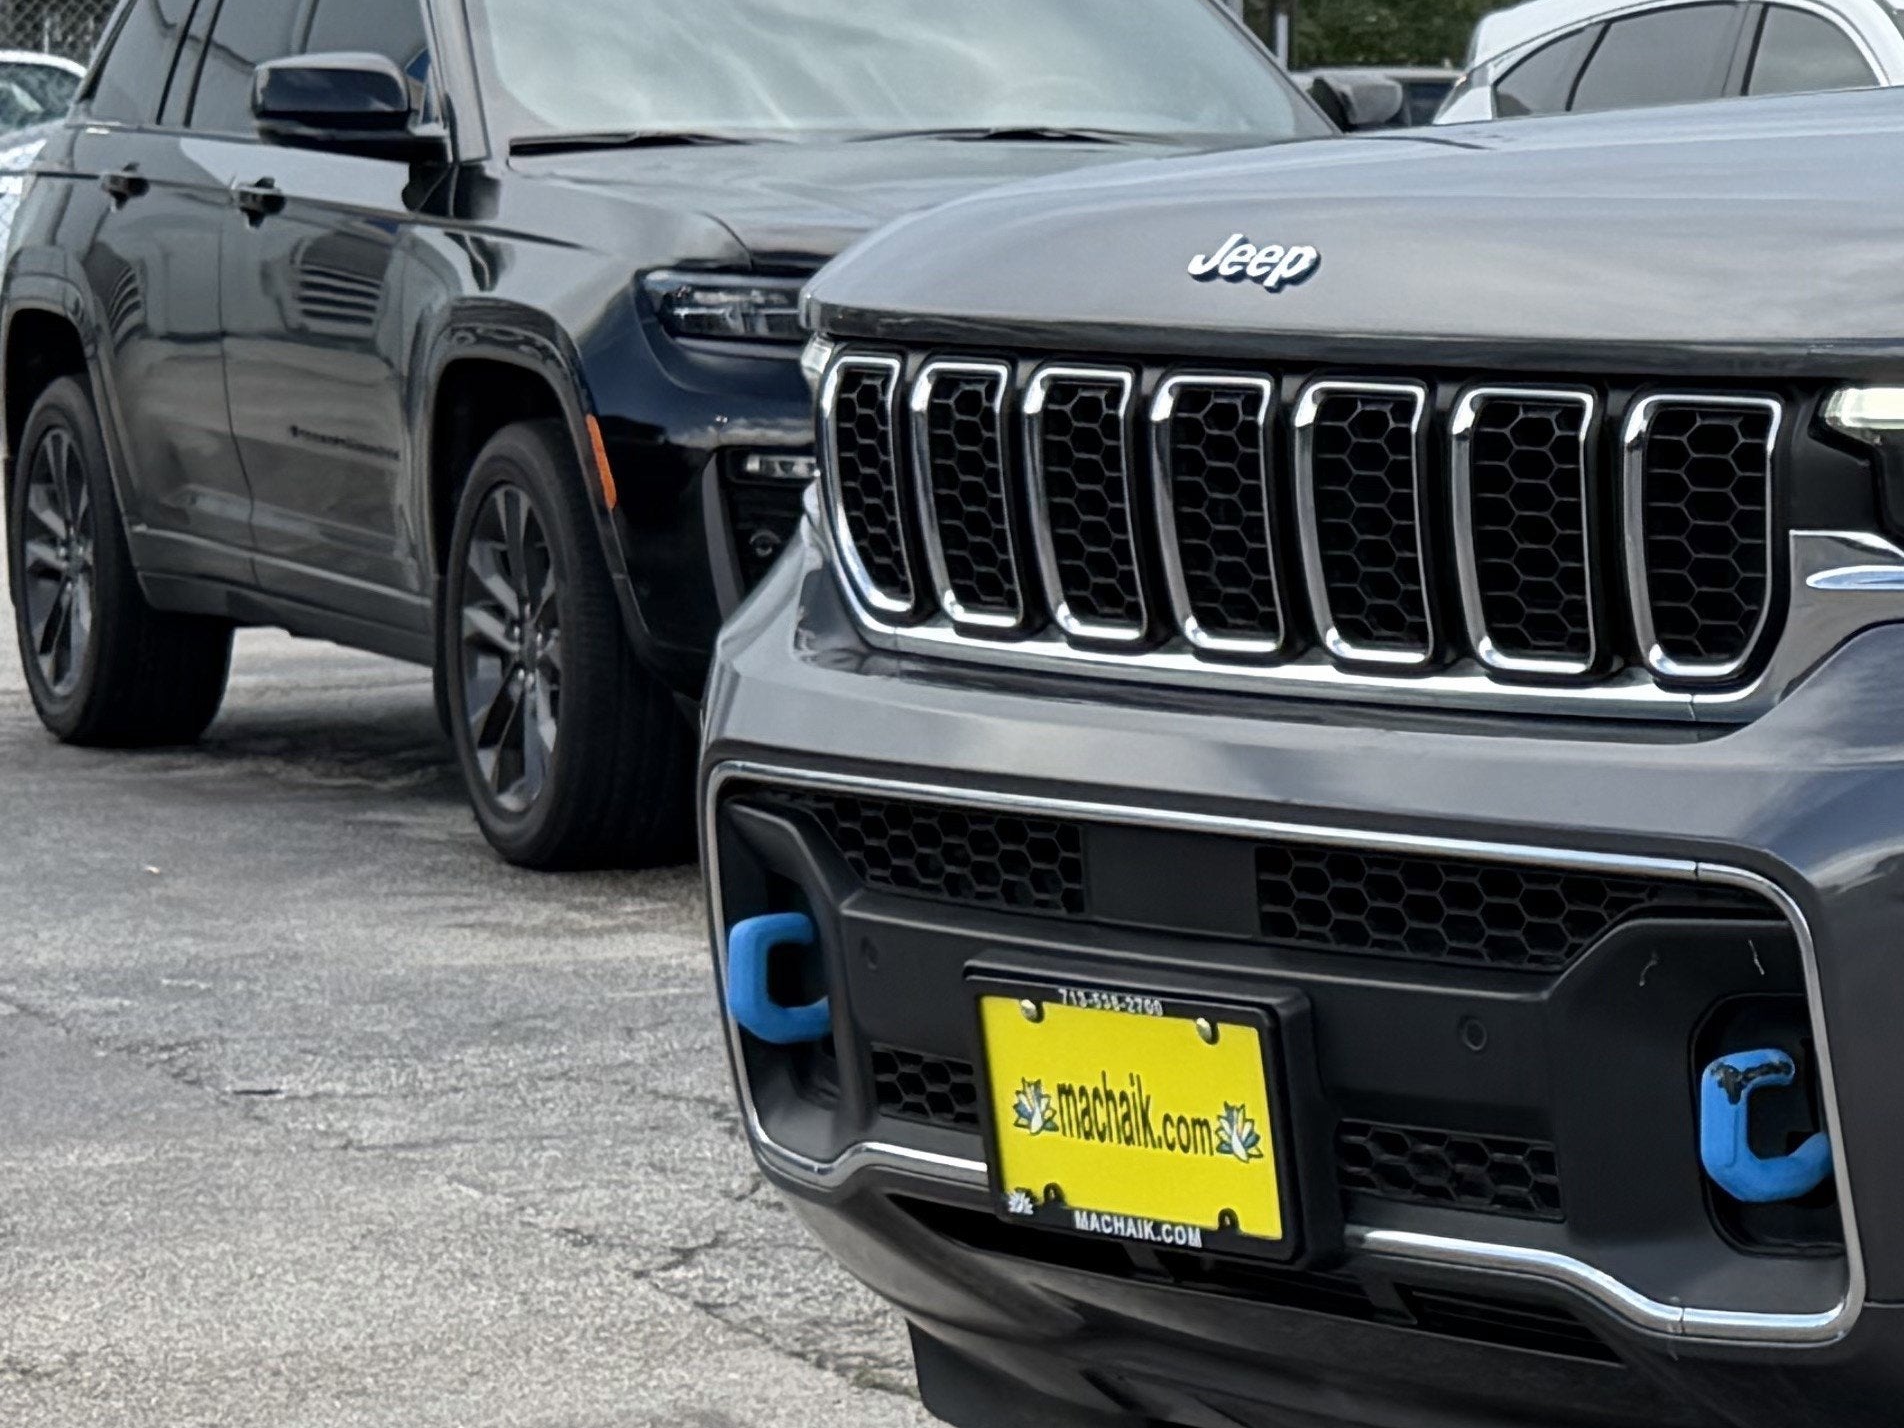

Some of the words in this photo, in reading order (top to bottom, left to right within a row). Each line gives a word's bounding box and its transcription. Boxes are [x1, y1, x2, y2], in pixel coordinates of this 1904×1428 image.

[1187, 233, 1320, 291] Jeep
[1057, 1070, 1215, 1156] machaik.com
[1073, 1209, 1204, 1248] MACHAIK.COM
